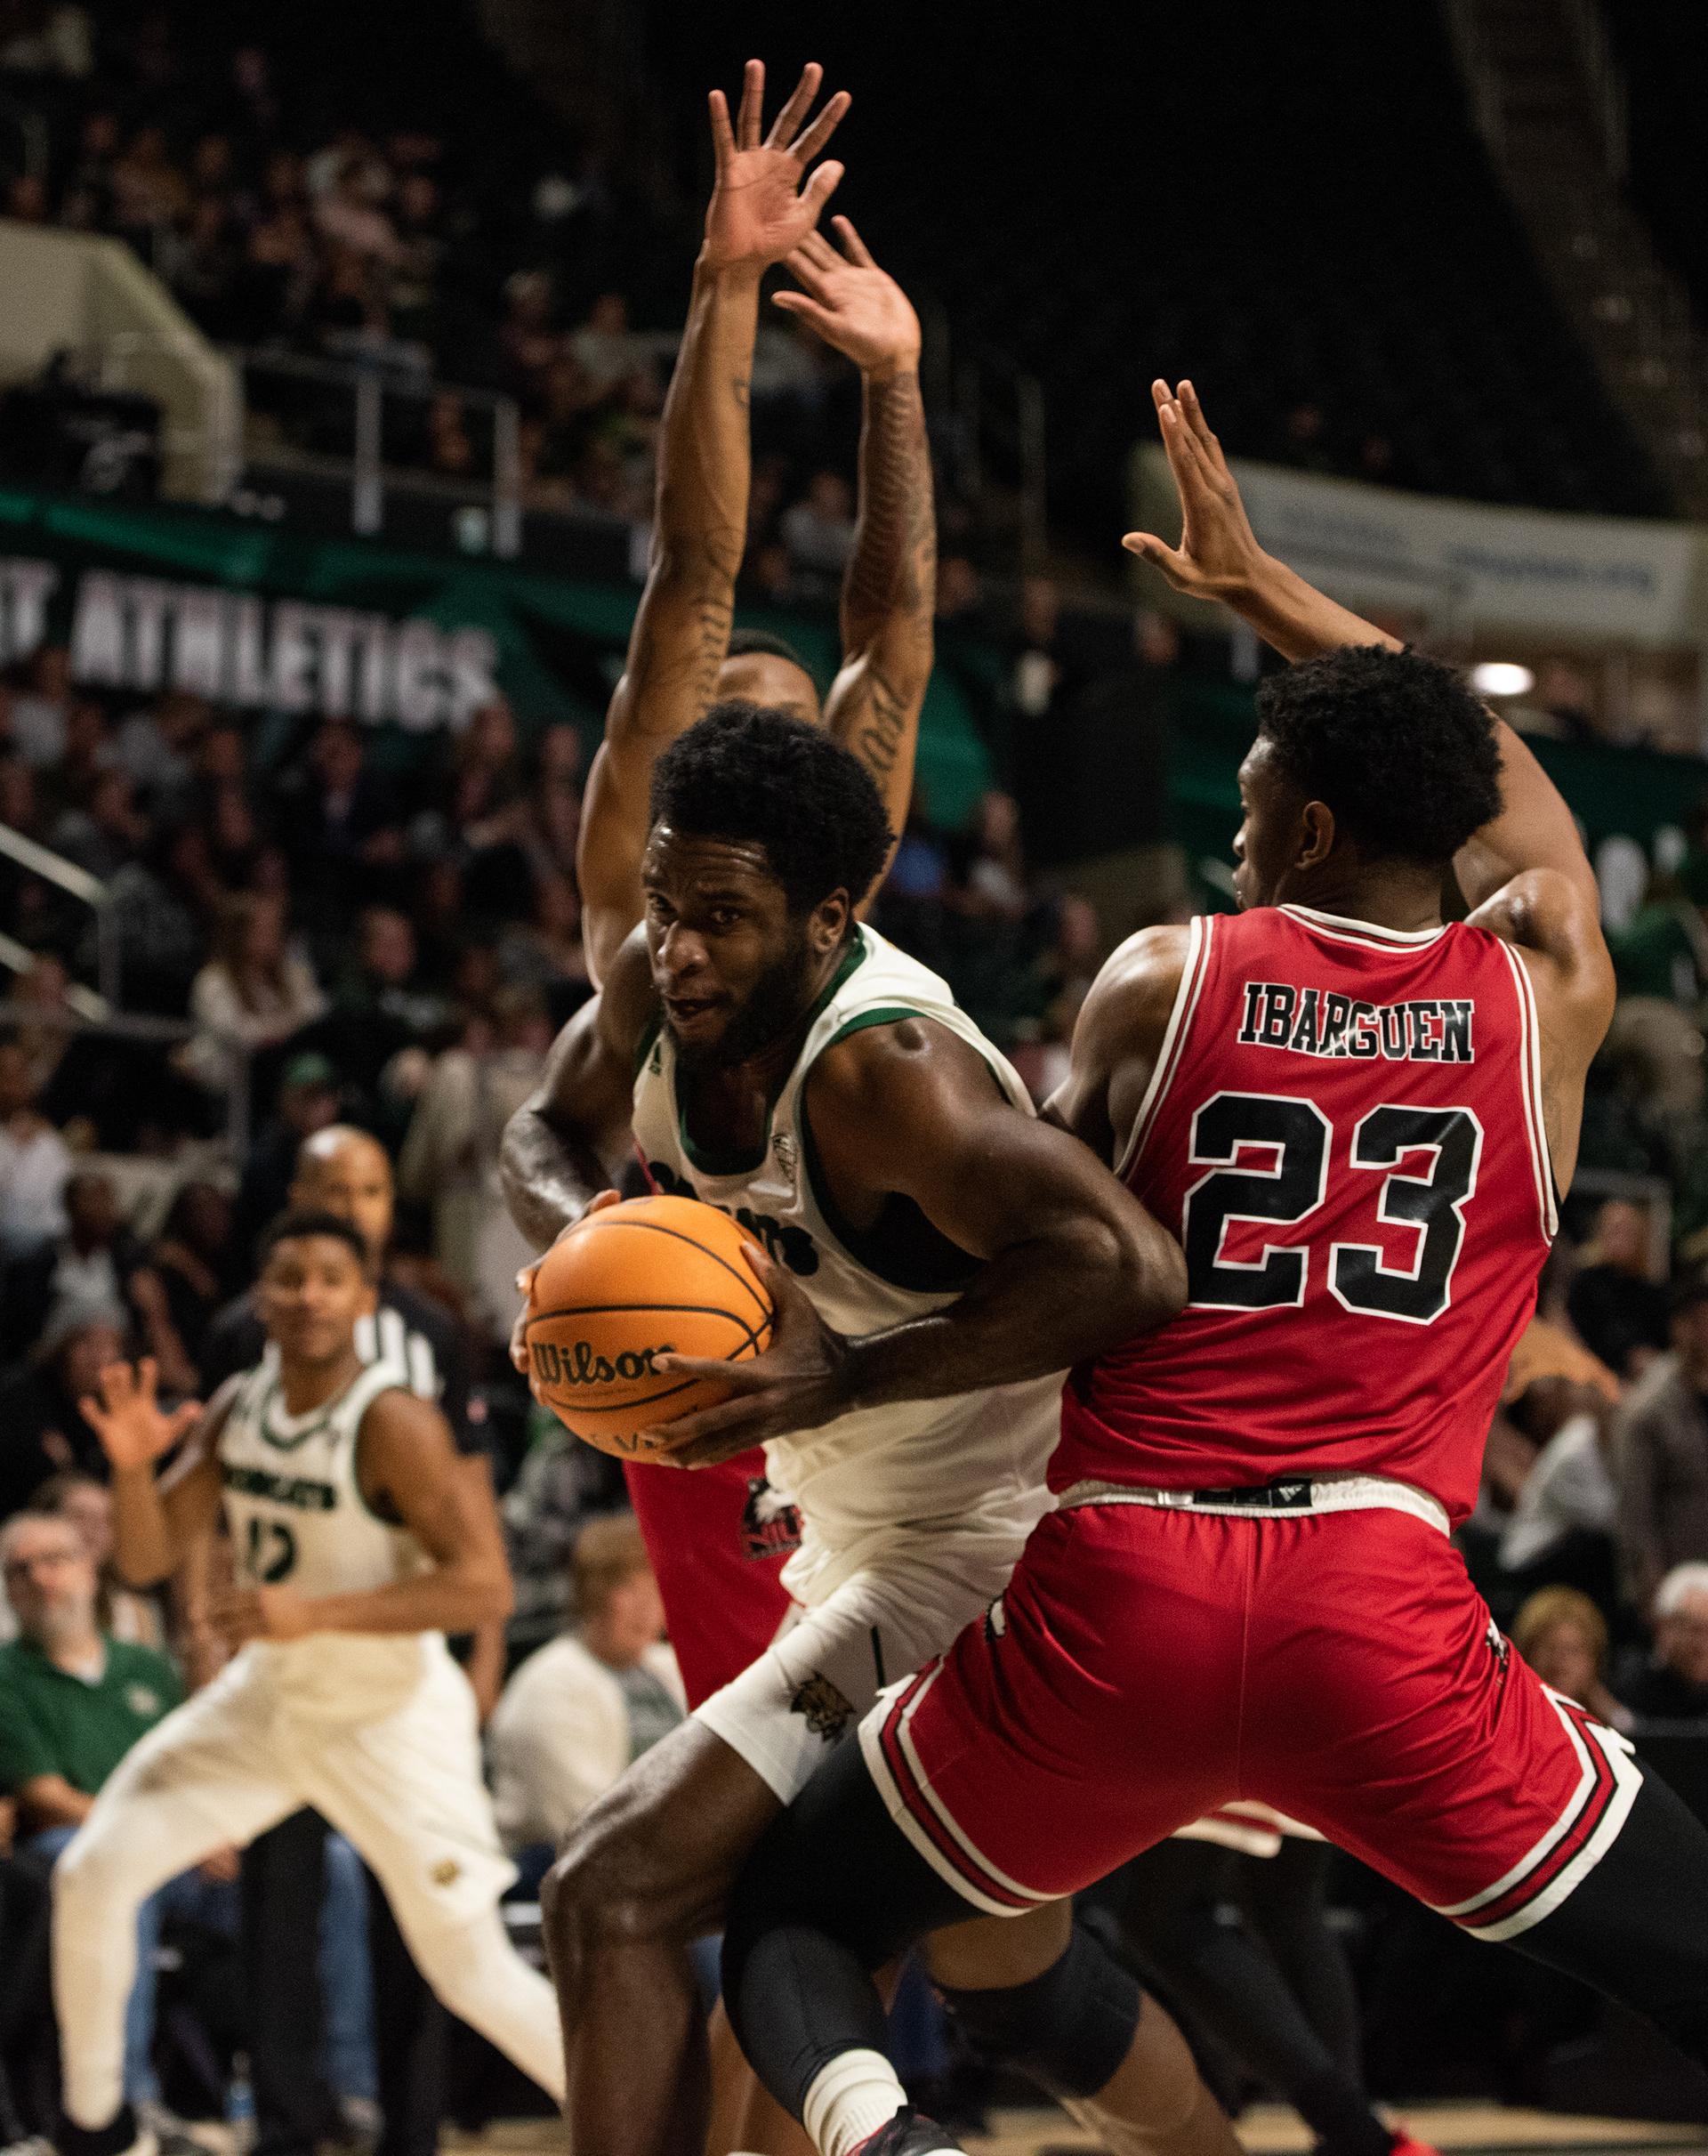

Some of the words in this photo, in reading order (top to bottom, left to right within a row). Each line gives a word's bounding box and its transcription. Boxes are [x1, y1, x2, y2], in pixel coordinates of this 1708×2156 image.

[73, 569, 498, 731] ATHLETICS
[1237, 981, 1475, 1063] IBARGUEN
[1182, 1091, 1485, 1326] 23
